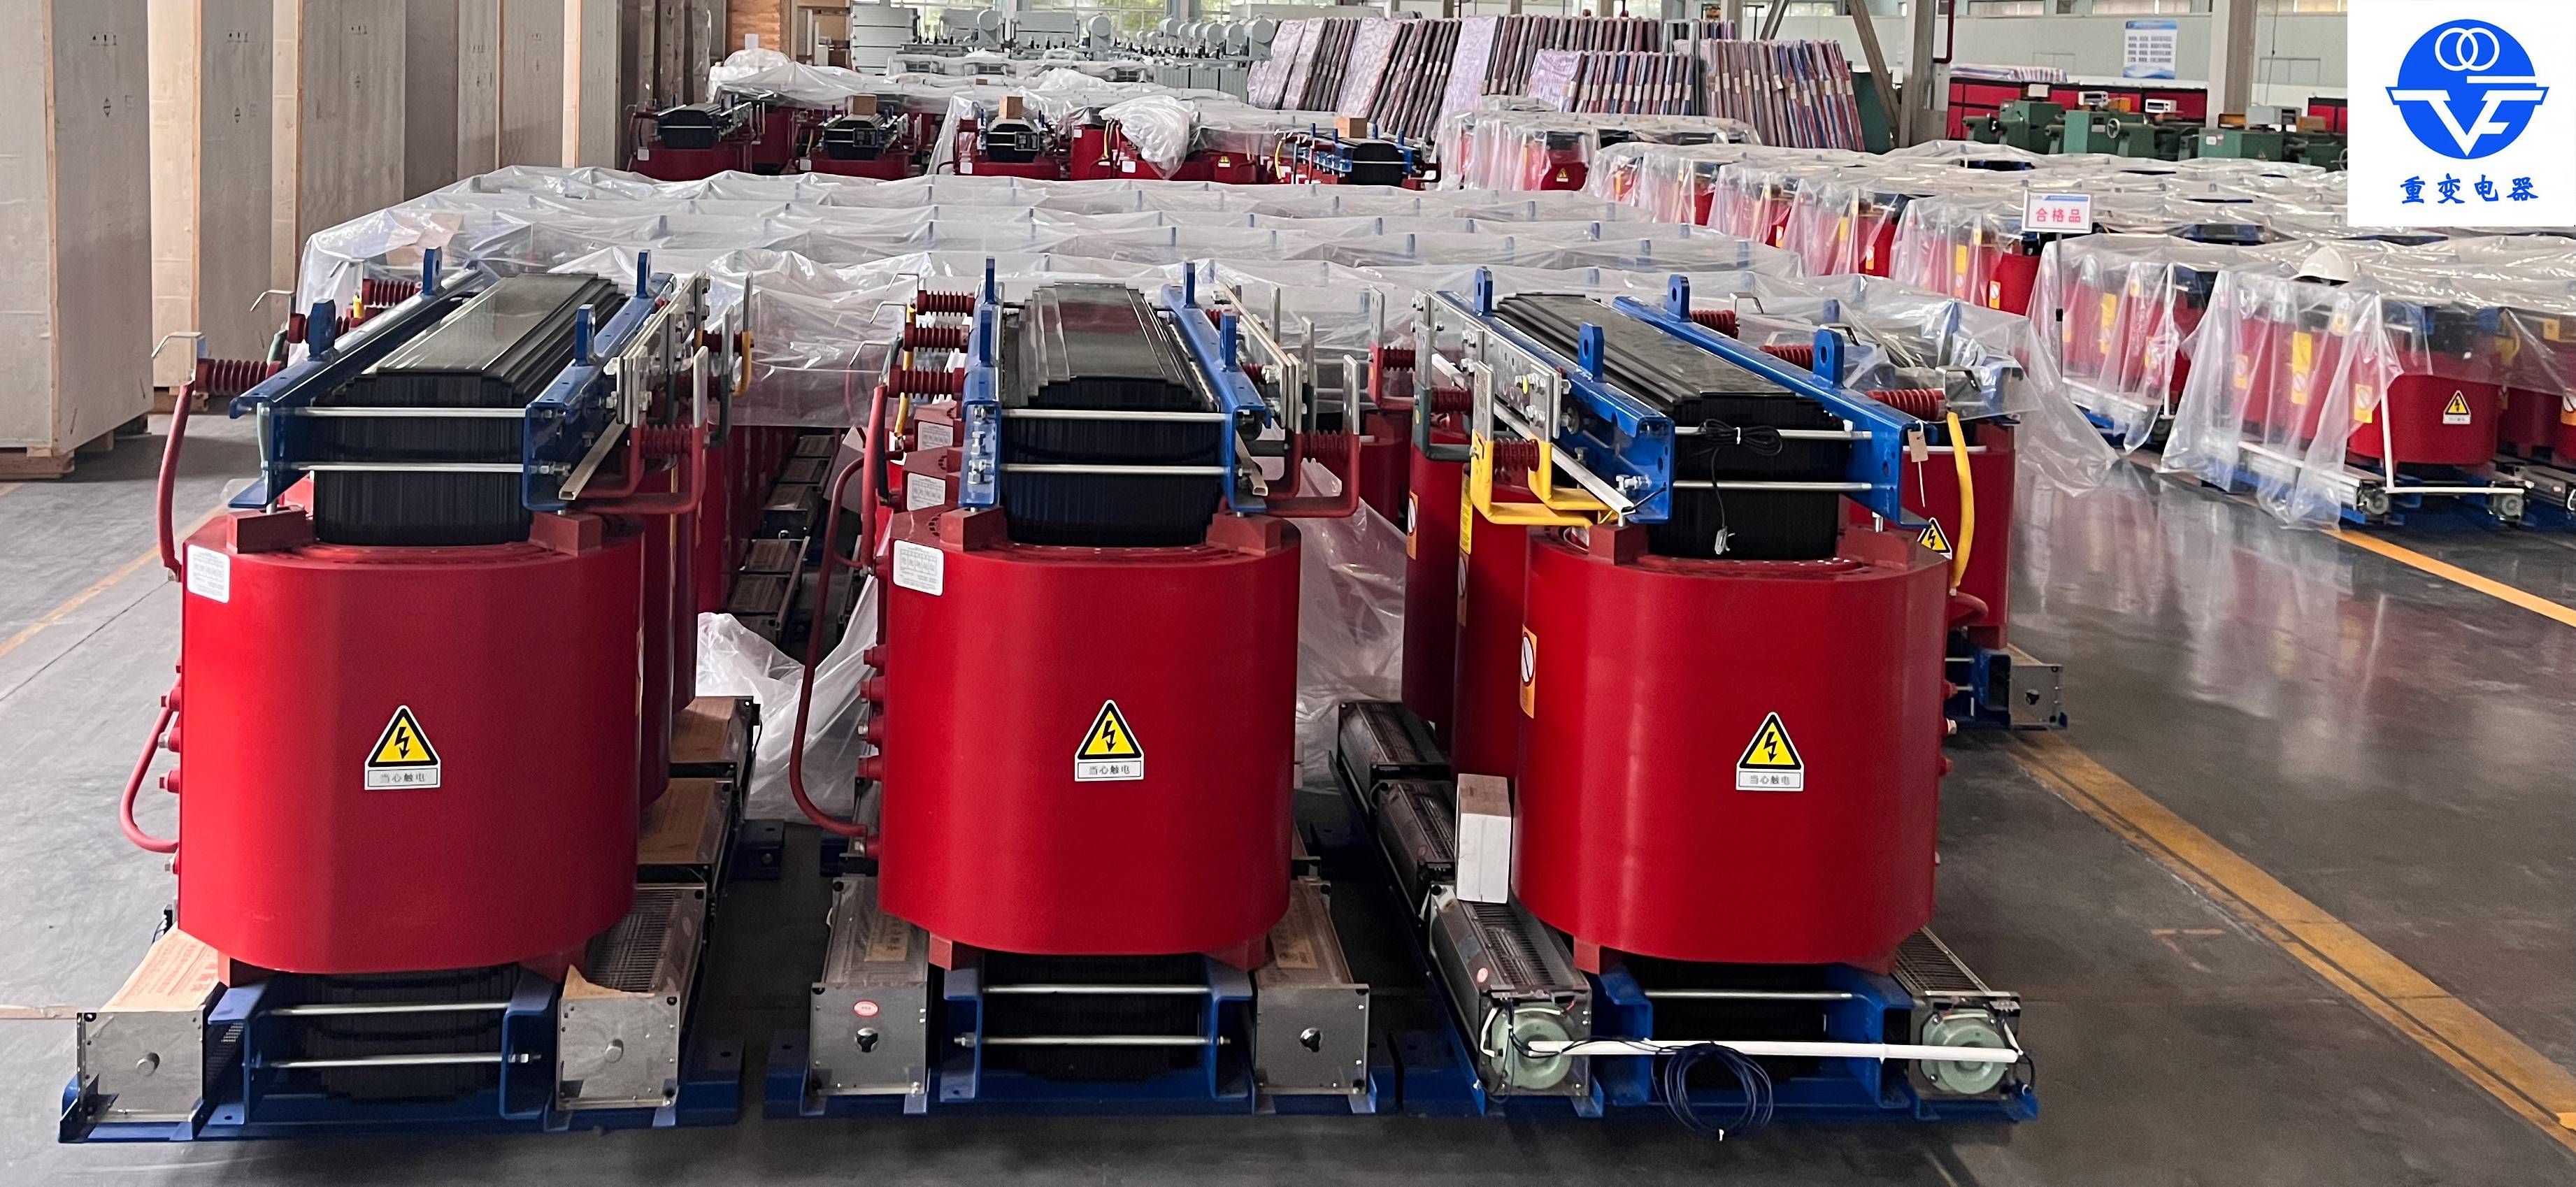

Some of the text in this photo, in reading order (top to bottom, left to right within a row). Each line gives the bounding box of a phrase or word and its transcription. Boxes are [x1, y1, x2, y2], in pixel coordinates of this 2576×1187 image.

[2035, 208, 2081, 222] 合格品
[1089, 765, 1130, 775] 当心触电
[380, 773, 425, 784] 当心触电
[1750, 775, 1790, 785] 当心触电
